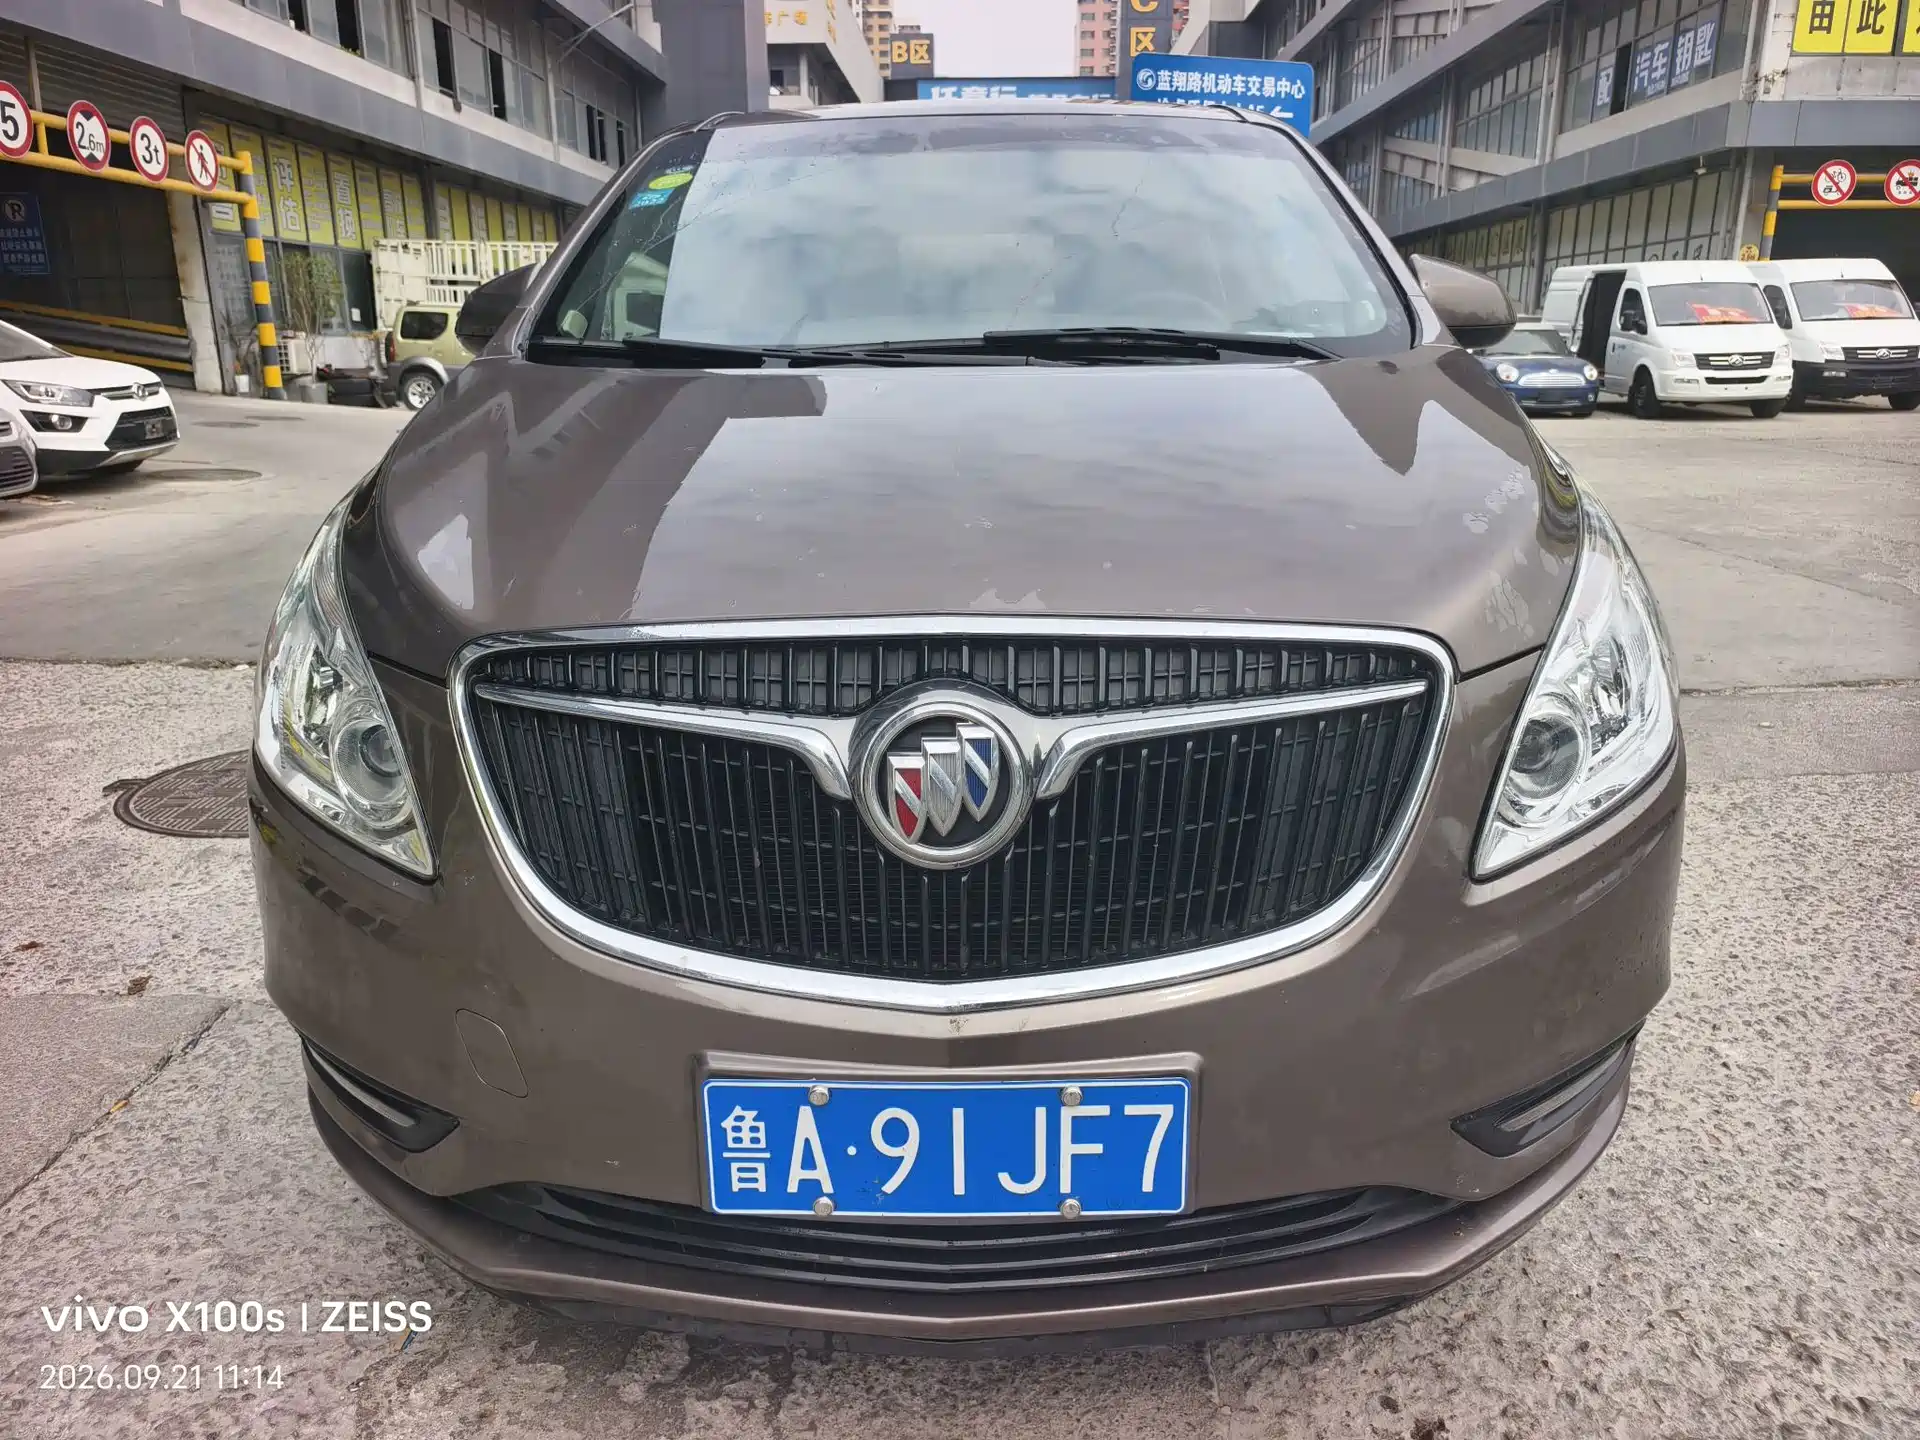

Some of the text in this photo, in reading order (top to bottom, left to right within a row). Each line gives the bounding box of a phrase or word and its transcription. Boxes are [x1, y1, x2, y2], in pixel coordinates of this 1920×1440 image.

[1808, 0, 1920, 34] 由此
[892, 39, 931, 64] B区
[1156, 69, 1305, 99] 蓝翔路机动车交易中心
[0, 100, 20, 142] 5
[75, 121, 105, 153] 2.6m
[140, 133, 161, 165] 3t
